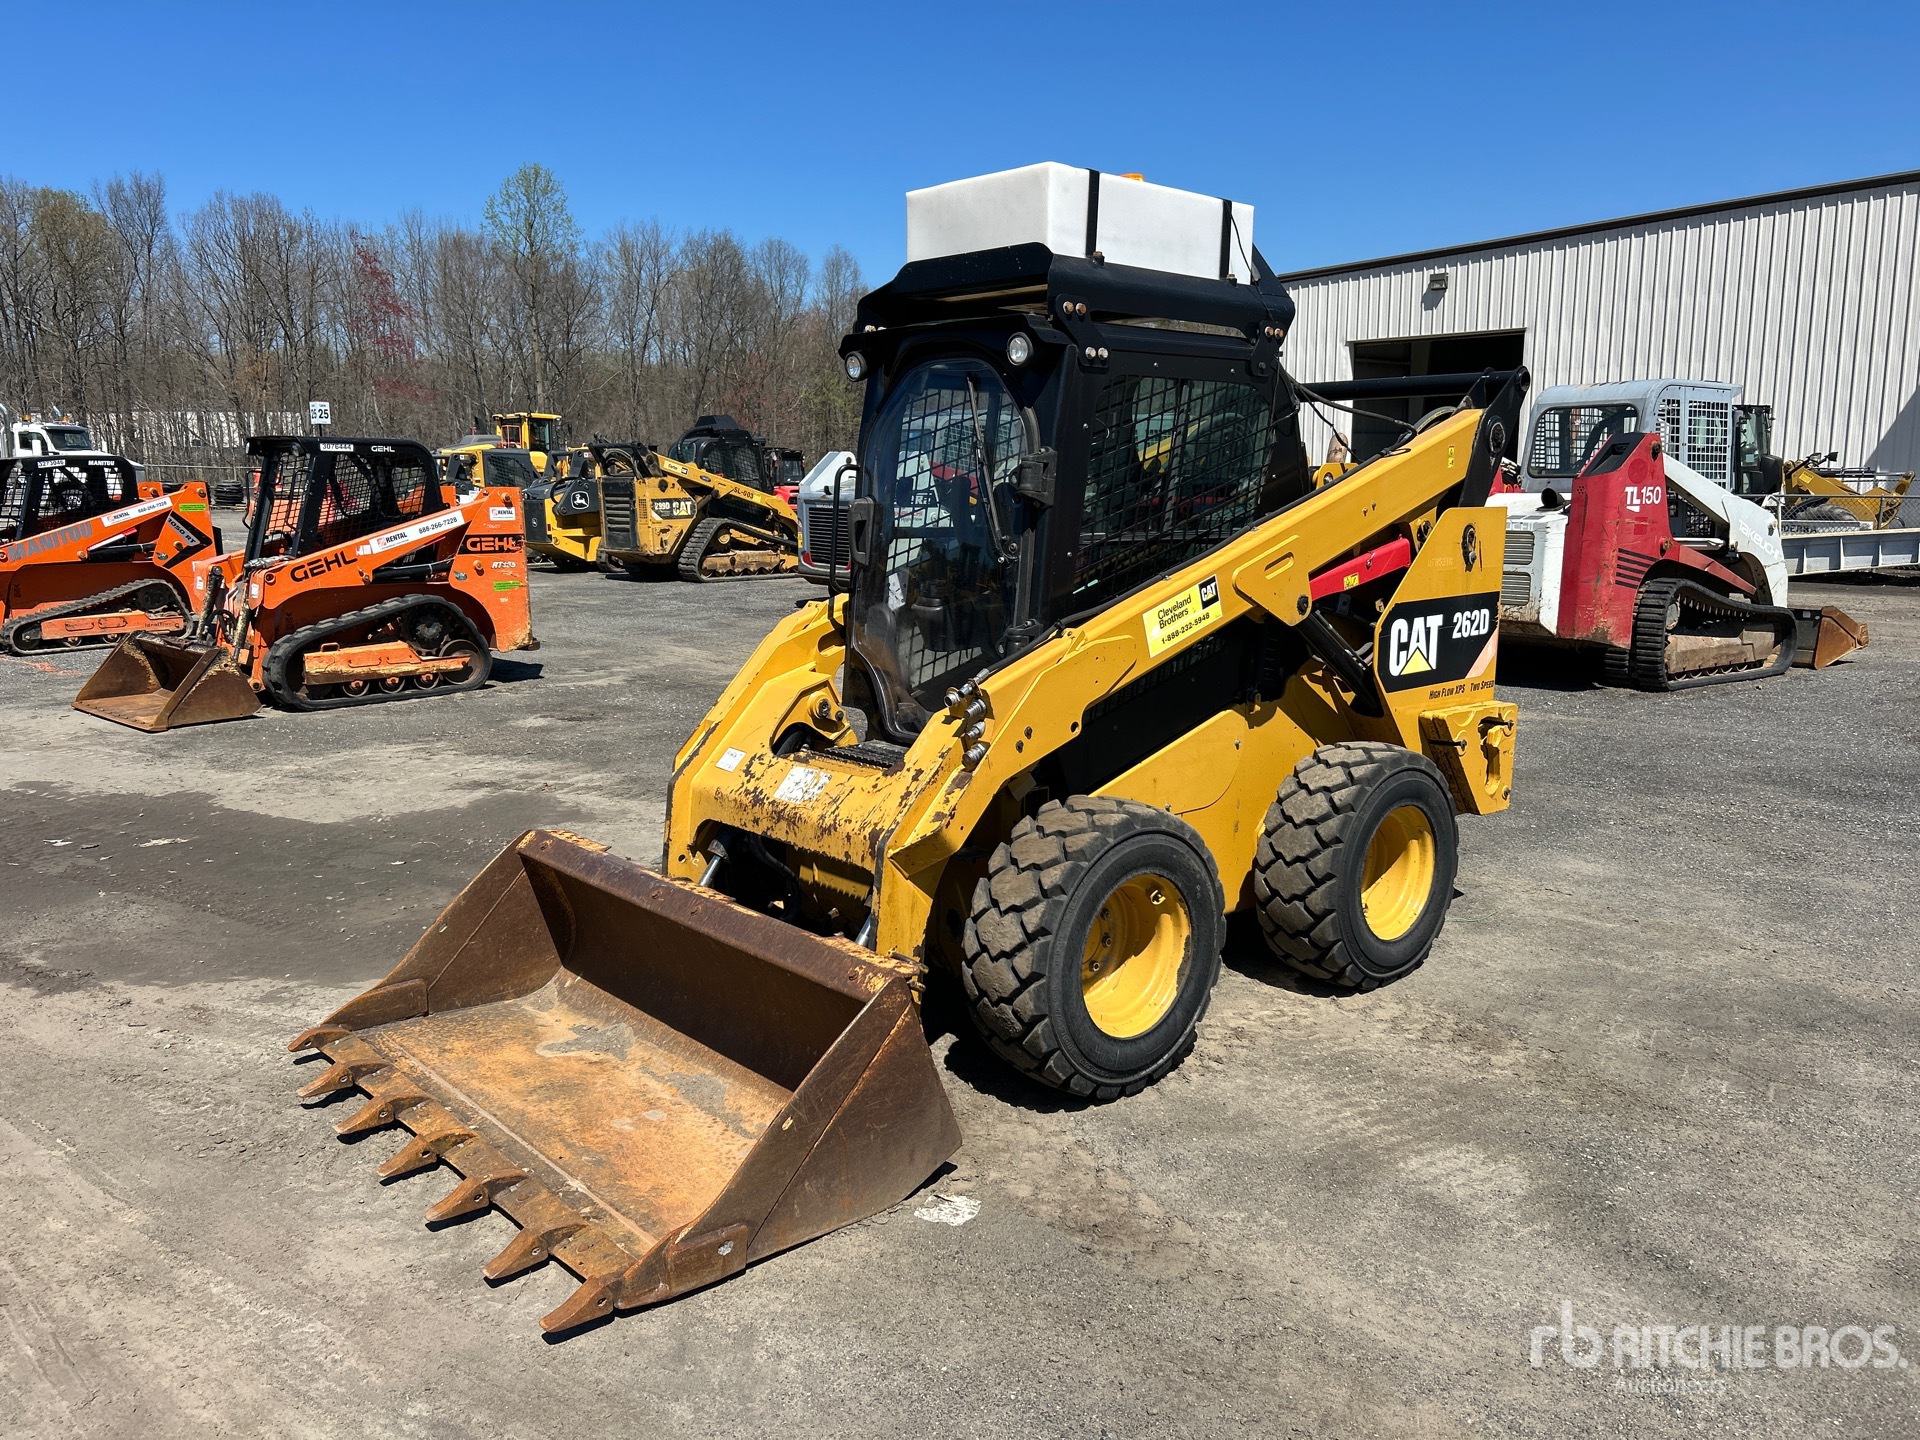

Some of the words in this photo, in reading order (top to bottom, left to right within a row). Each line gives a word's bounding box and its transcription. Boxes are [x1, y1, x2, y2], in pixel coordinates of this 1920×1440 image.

[318, 409, 329, 419] 25
[1625, 486, 1662, 505] TL150
[673, 501, 691, 515] CAT
[8, 521, 93, 562] MANITOU
[185, 533, 197, 544] RT
[386, 532, 408, 544] RENTAL
[466, 537, 521, 552] GEHL
[290, 551, 358, 582] GEHL
[1200, 582, 1217, 601] CAT
[1158, 594, 1192, 619] Cleveland
[1159, 608, 1189, 629] Brothers
[1161, 612, 1210, 644] 1-888-232-5948
[1452, 608, 1490, 639] 262D
[1389, 614, 1443, 677] CAT
[1454, 684, 1465, 695] XPS
